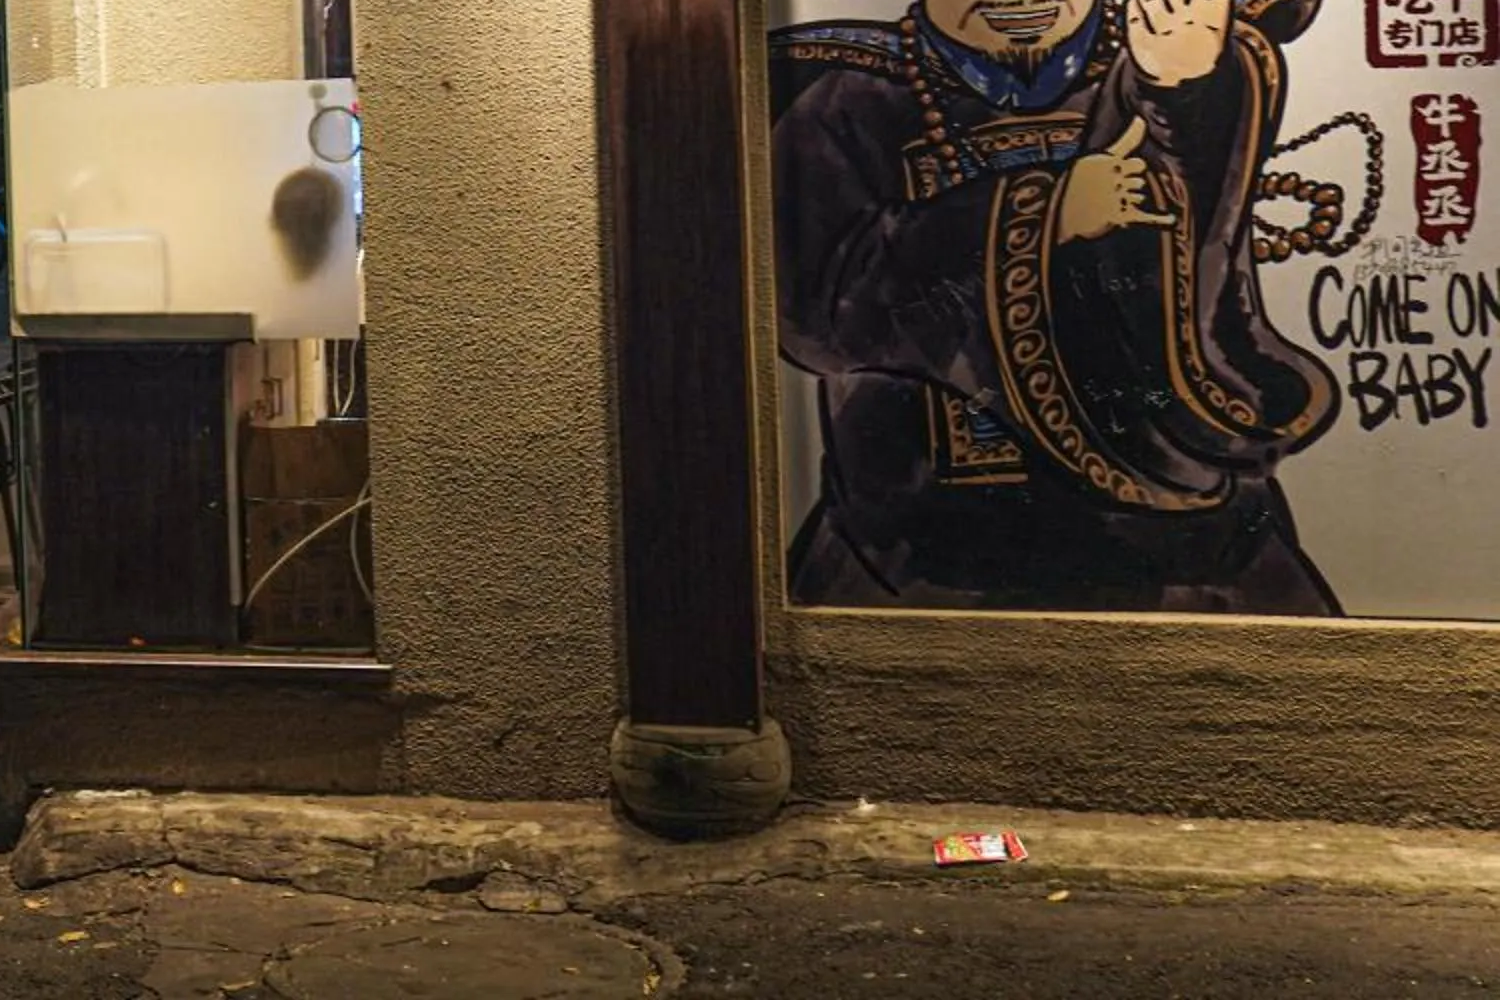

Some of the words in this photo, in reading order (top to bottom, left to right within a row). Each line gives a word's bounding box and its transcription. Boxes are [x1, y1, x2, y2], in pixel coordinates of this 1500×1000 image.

[1384, 17, 1481, 49] 专门店
[1415, 98, 1472, 226] 牛丞丞
[1308, 264, 1435, 350] COME
[1447, 267, 1500, 338] ON
[1348, 347, 1493, 432] BABY
